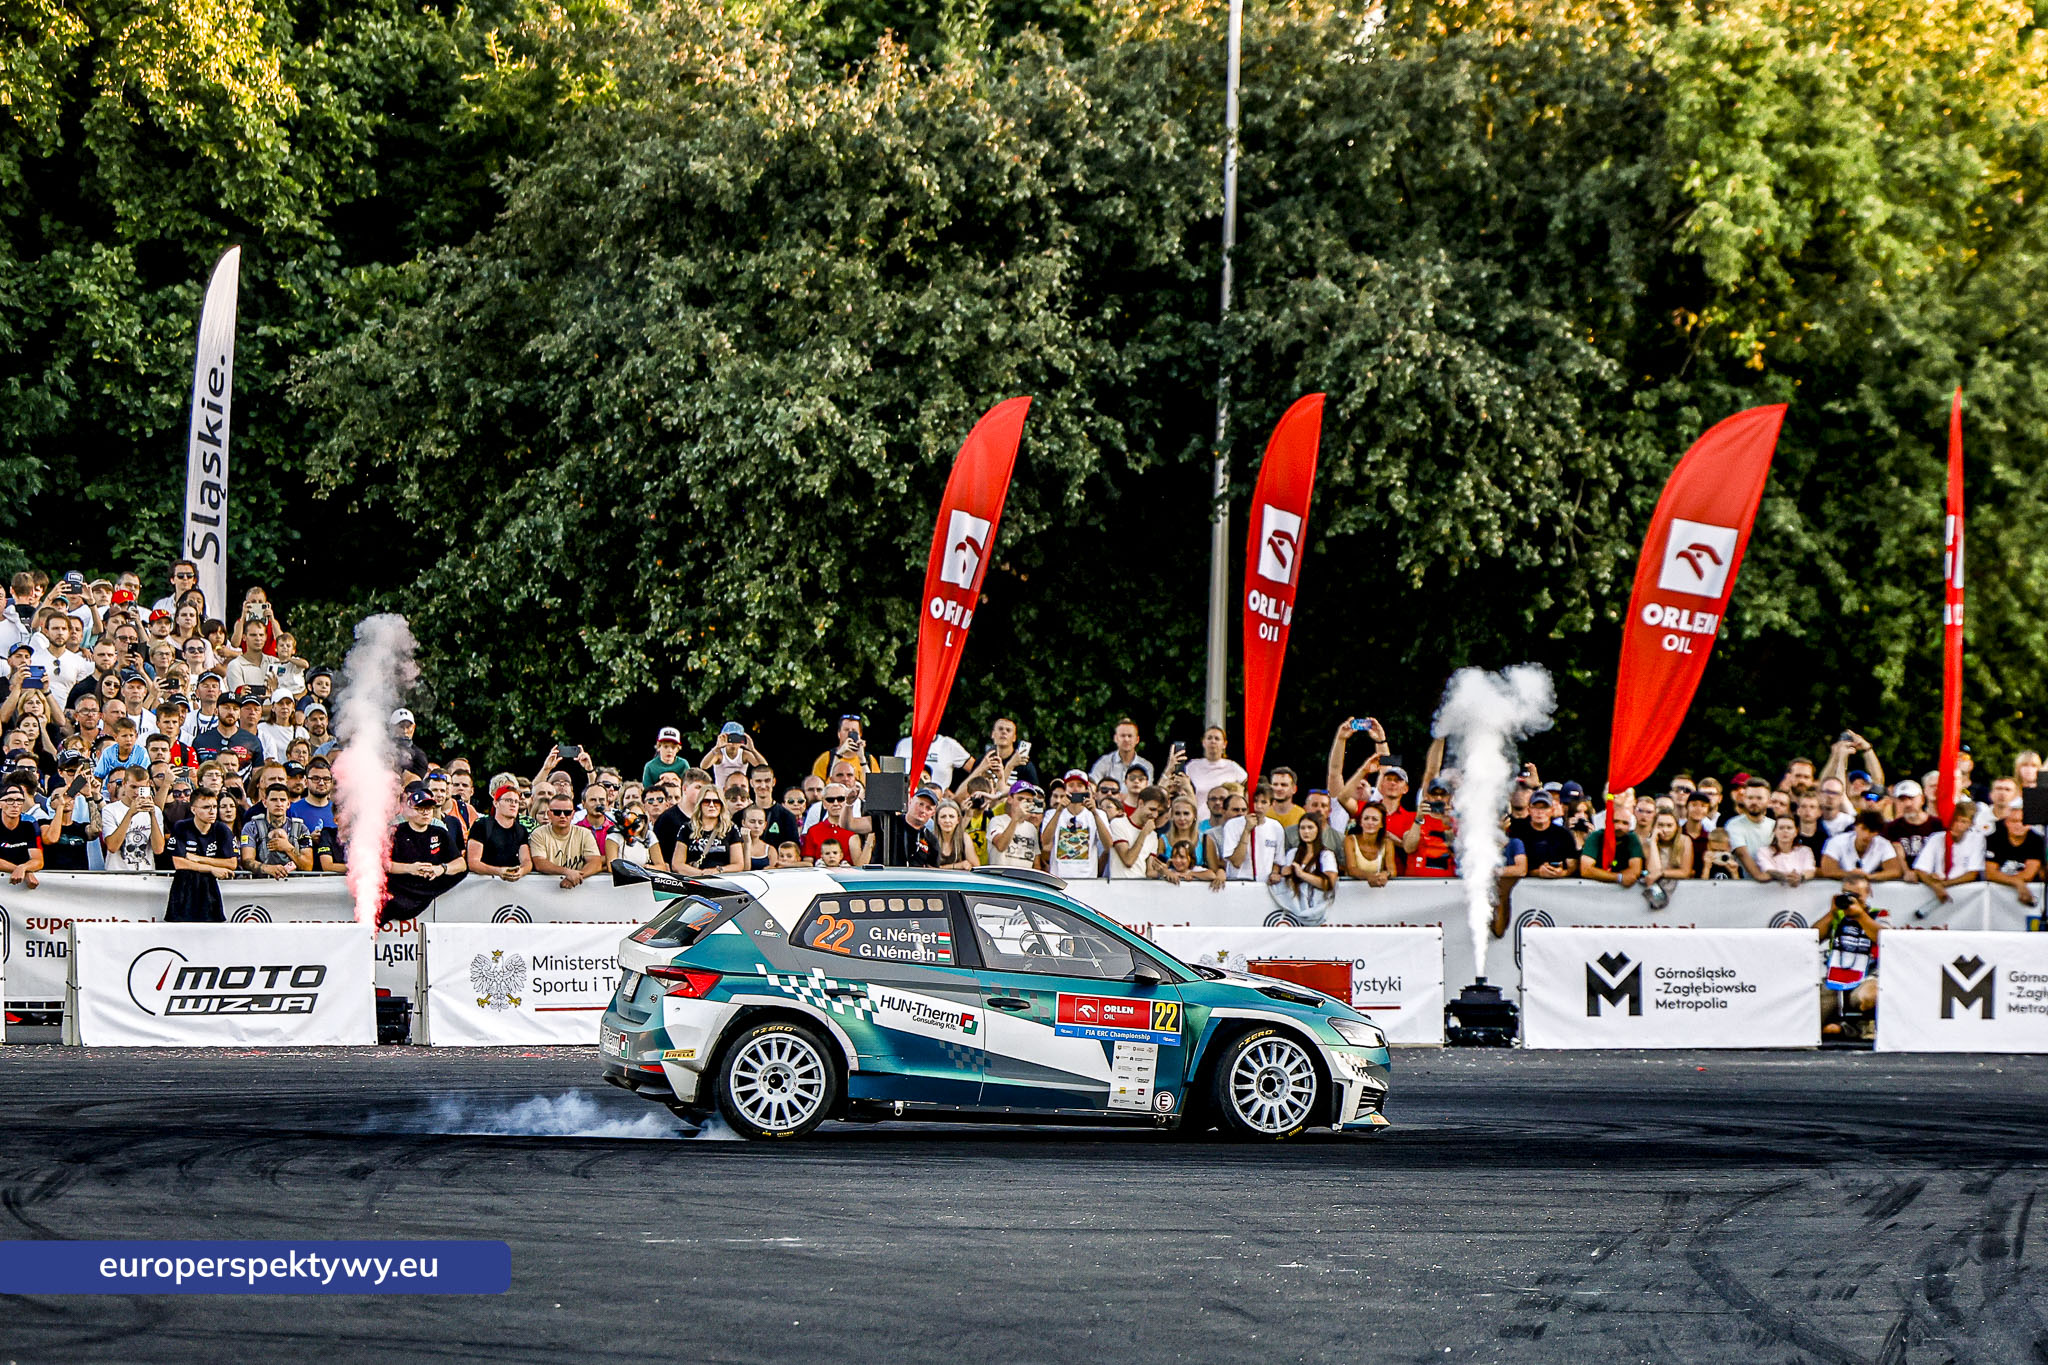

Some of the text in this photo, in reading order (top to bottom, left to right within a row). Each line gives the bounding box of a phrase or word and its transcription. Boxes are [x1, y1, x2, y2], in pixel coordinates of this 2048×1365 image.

[1248, 589, 1293, 626] ORL
[1642, 602, 1719, 635] ORLEN
[1662, 634, 1693, 654] OIL
[812, 915, 855, 954] 22
[869, 927, 937, 944] G.Német
[859, 944, 936, 962] G.Németh
[173, 965, 327, 990] MOTO
[1655, 966, 1736, 981] Górnośląsko
[532, 977, 588, 996] Sportu
[594, 977, 597, 992] i
[167, 995, 315, 1014] WIZJA
[880, 994, 960, 1025] HUN-Therm
[1103, 1005, 1134, 1014] ORLEN
[1655, 998, 1728, 1012] Metropolia
[912, 1014, 945, 1029] Consulting
[1103, 1013, 1116, 1021] OIL
[1154, 1002, 1178, 1031] 22
[1109, 1031, 1151, 1041] Championship
